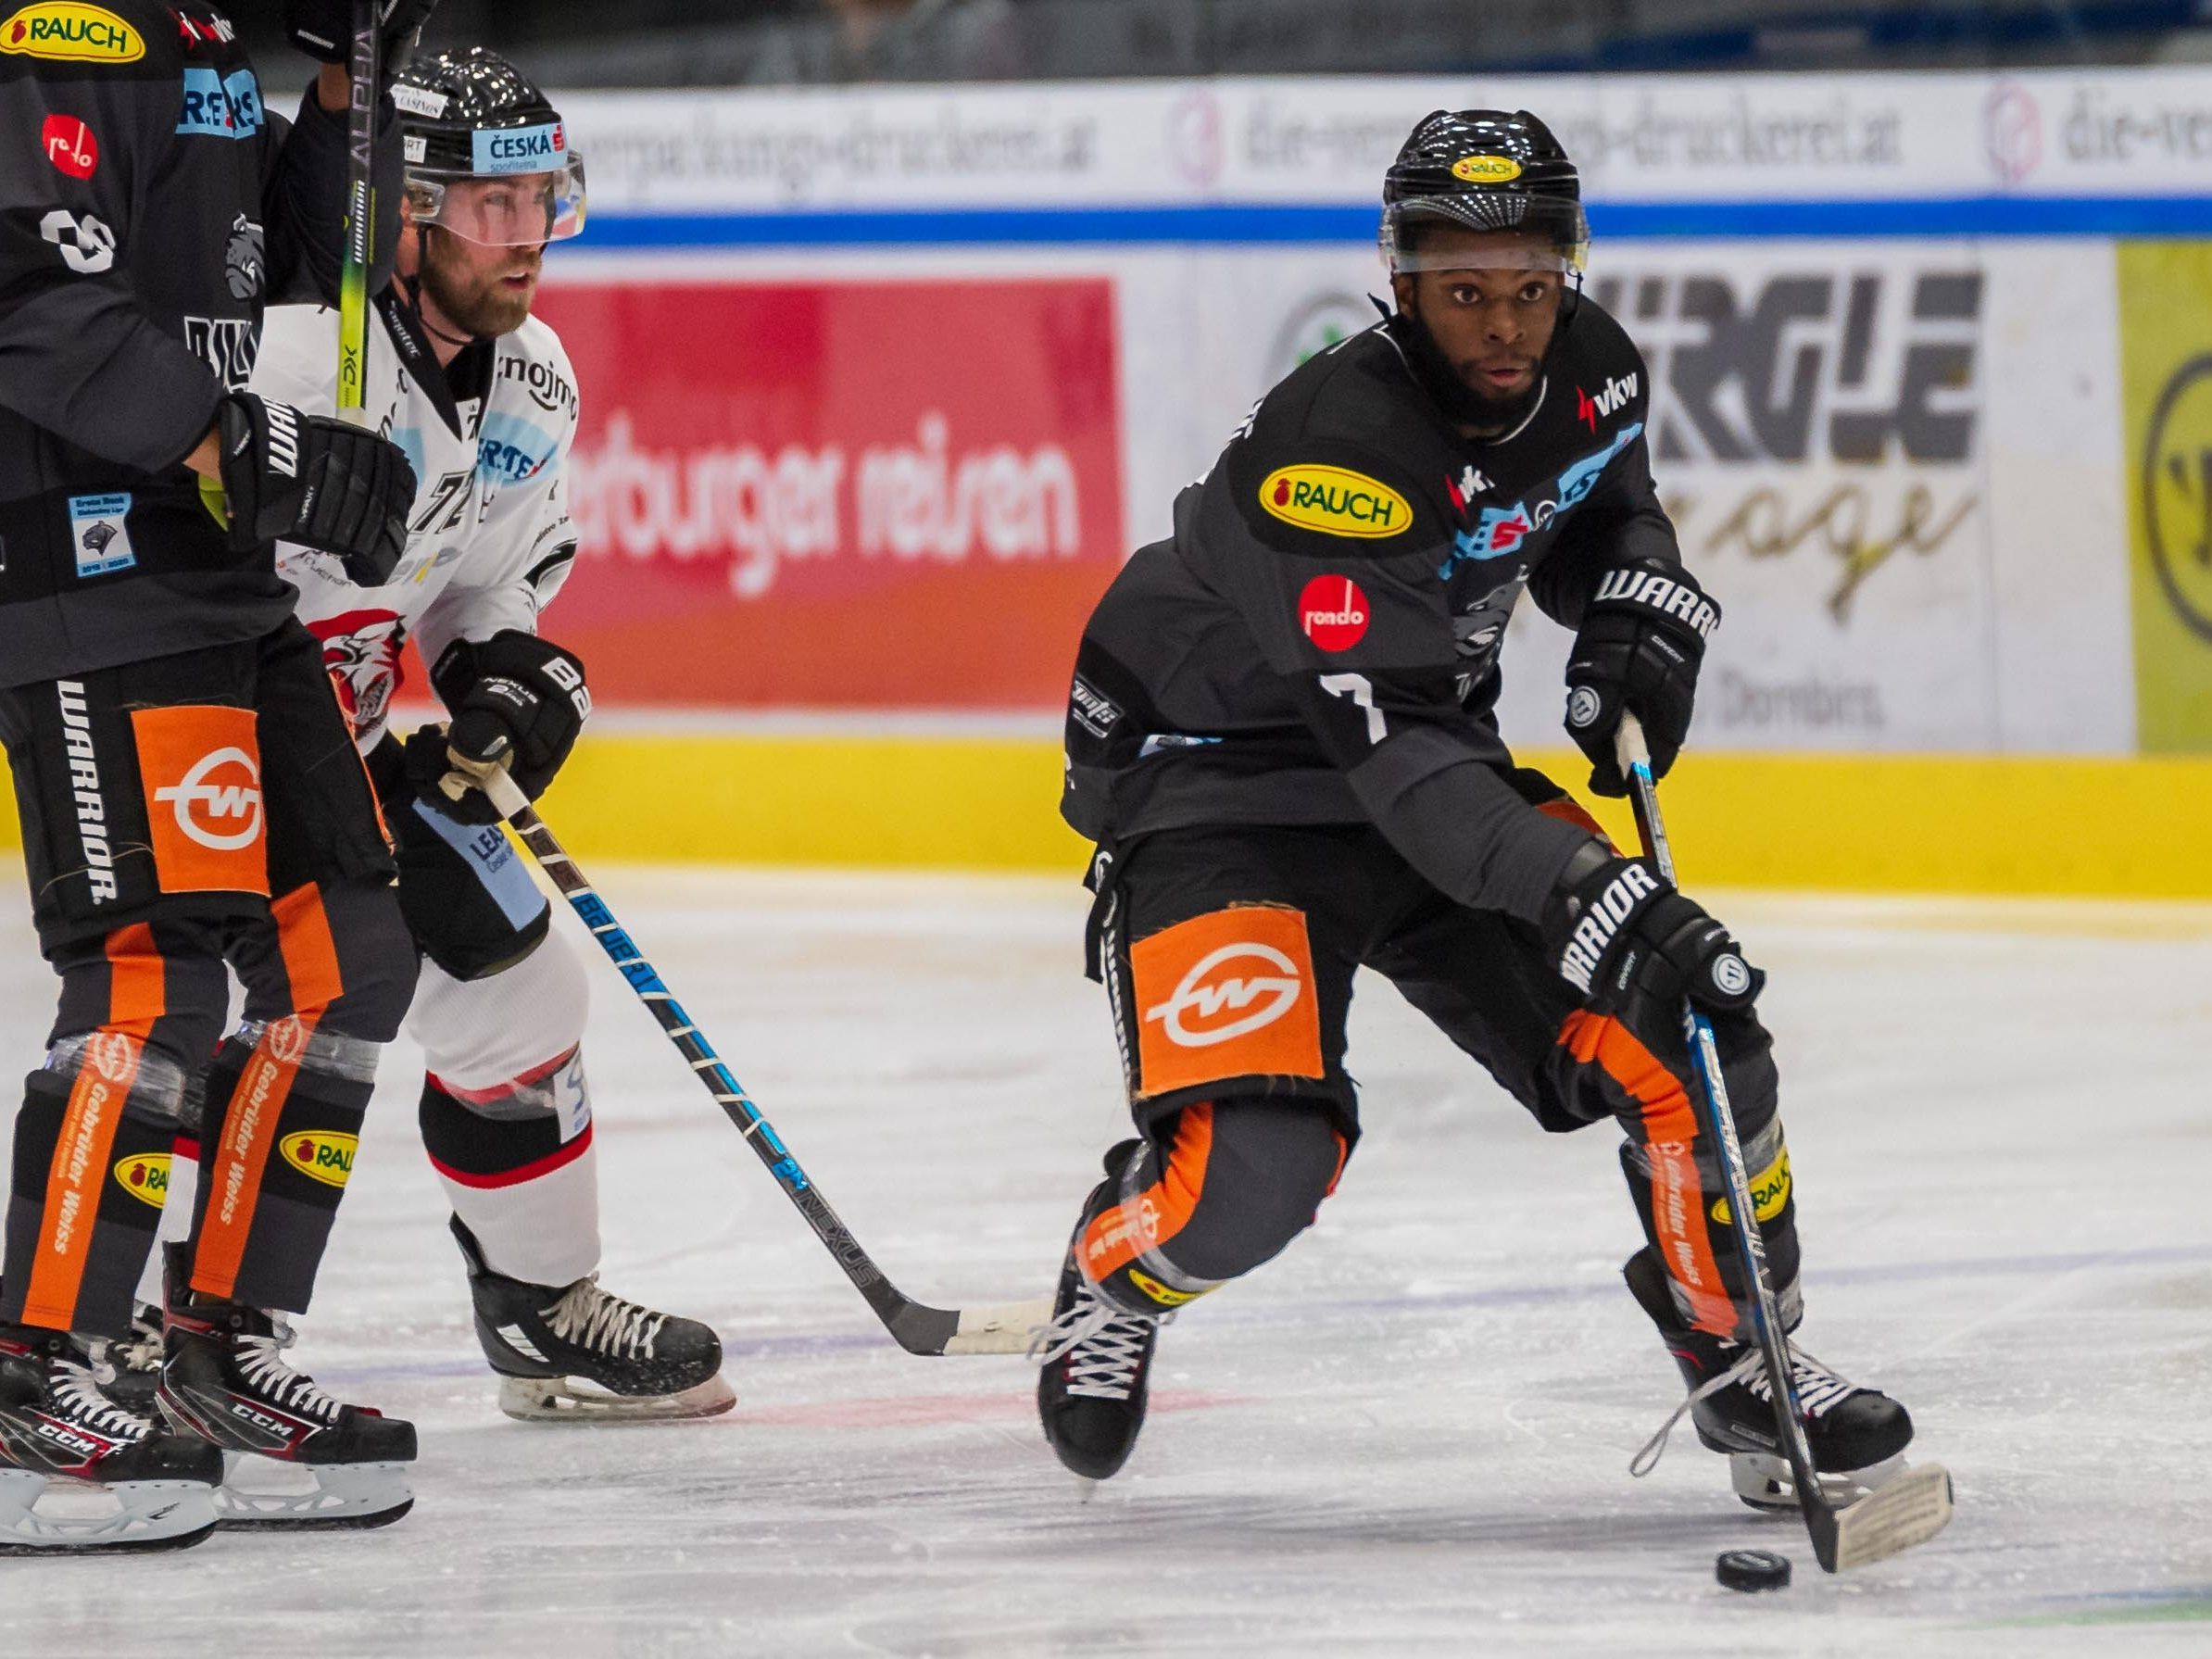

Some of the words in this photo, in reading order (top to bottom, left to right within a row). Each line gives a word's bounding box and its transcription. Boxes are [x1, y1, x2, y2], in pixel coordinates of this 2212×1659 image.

[31, 18, 127, 53] RAUCH
[350, 30, 374, 168] ALPHA
[490, 130, 551, 159] ČESKÁ
[1592, 372, 1639, 417] vkw
[856, 408, 1080, 559] reisen
[1293, 480, 1393, 527] RAUCH
[1304, 578, 1364, 637] rondo
[1319, 672, 1389, 745] 7
[57, 680, 118, 901] WARRIOR
[55, 1189, 81, 1255] Weiss
[220, 1162, 245, 1225] Weiss
[794, 1188, 880, 1288] NEXUS
[37, 1423, 94, 1454] CCM
[232, 1402, 295, 1438] CCM
